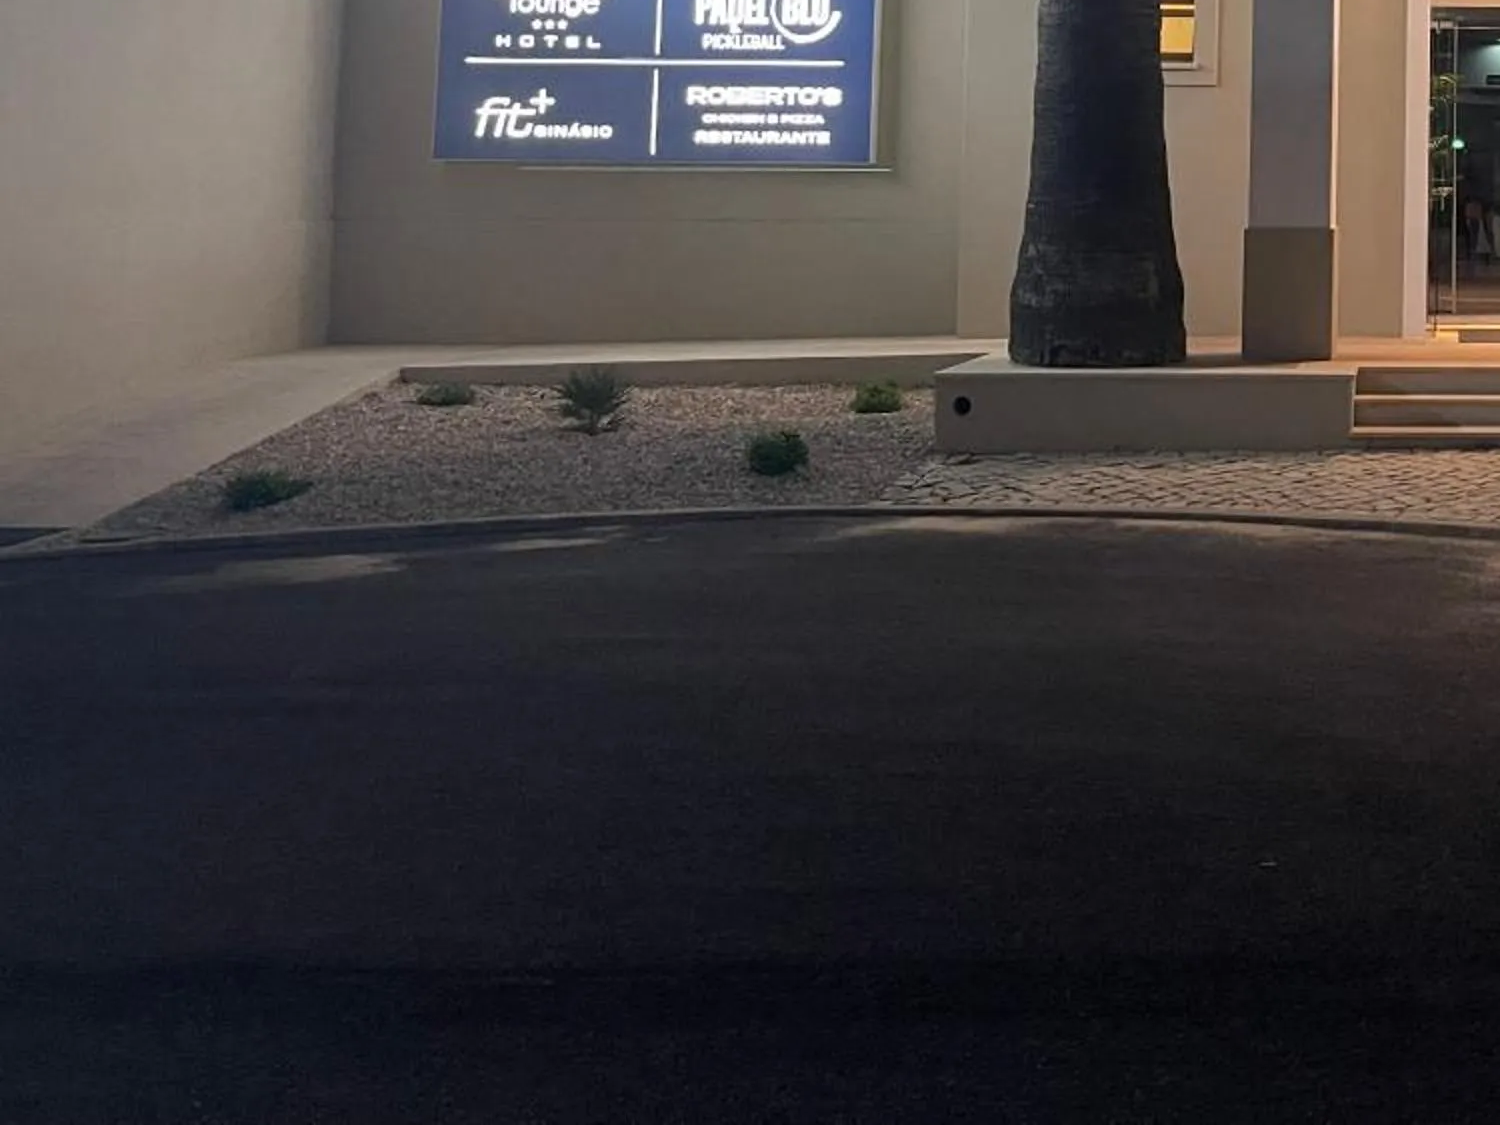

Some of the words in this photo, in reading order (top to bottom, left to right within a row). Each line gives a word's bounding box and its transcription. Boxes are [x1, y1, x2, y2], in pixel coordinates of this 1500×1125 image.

[495, 34, 602, 49] HOTEL
[702, 33, 786, 50] PICKLEBALL
[685, 86, 843, 106] ROBERTO'S
[694, 130, 831, 145] RESTAURANTE
